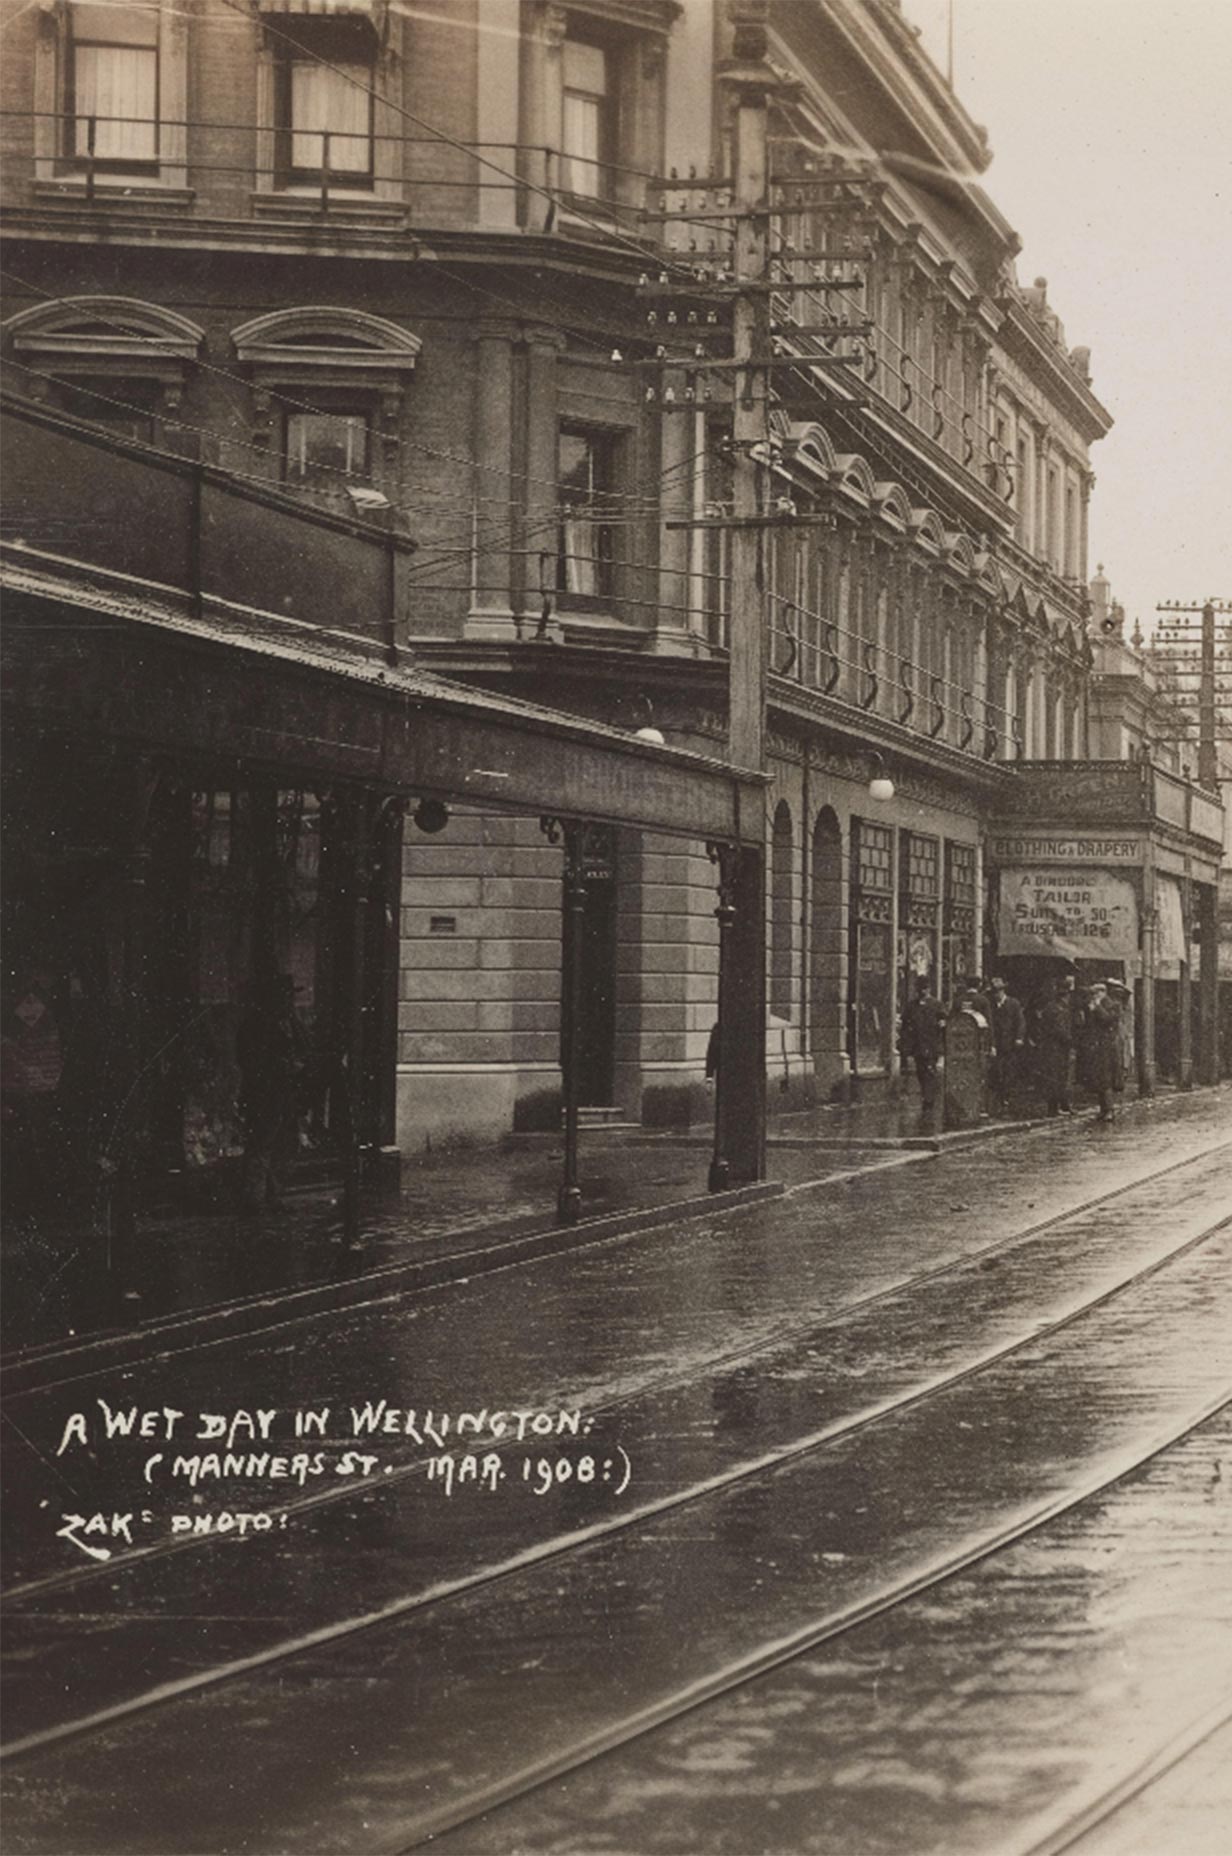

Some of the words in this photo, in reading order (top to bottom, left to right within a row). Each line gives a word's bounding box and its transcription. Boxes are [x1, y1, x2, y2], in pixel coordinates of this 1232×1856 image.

[995, 841, 1067, 856] CLOTHING
[1077, 841, 1137, 857] DRAPERY
[1033, 889, 1091, 905] TAILOR
